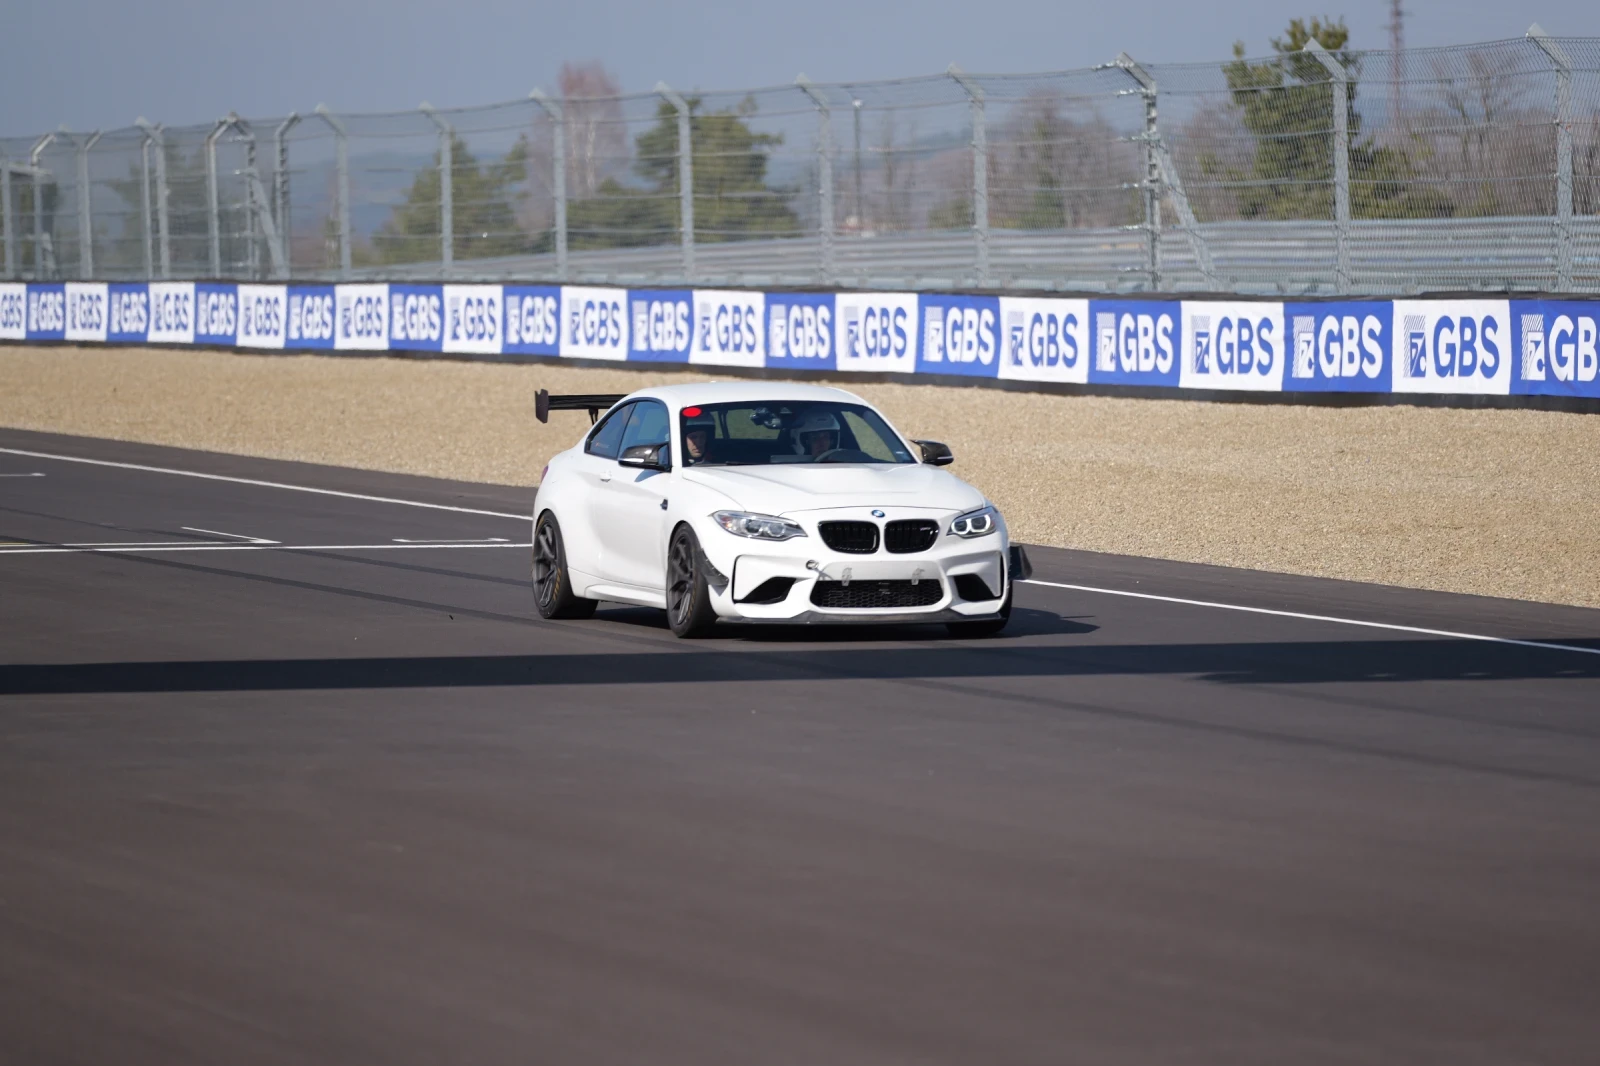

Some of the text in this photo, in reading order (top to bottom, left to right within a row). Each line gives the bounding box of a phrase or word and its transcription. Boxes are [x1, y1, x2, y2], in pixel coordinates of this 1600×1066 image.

[1, 294, 22, 329] GBS
[39, 292, 64, 331] GBS
[80, 293, 102, 331] GBS
[119, 293, 147, 332] GBS
[163, 293, 189, 331] GBS
[207, 293, 236, 335] GBS
[255, 296, 280, 336] GBS
[301, 296, 332, 339] GBS
[354, 297, 382, 337] GBS
[404, 295, 440, 341] GBS
[464, 298, 496, 341] GBS
[520, 296, 556, 344] GBS
[584, 300, 620, 347] GBS
[650, 301, 689, 351] GBS
[716, 304, 756, 353] GBS
[788, 305, 830, 358] GBS
[864, 307, 907, 358] GBS
[946, 307, 994, 365] GBS
[1030, 313, 1078, 368] GBS
[1119, 313, 1173, 373] GBS
[1216, 317, 1273, 376] GBS
[1319, 315, 1382, 378] GBS
[1433, 315, 1499, 379] GBS
[1549, 315, 1600, 381] GB
